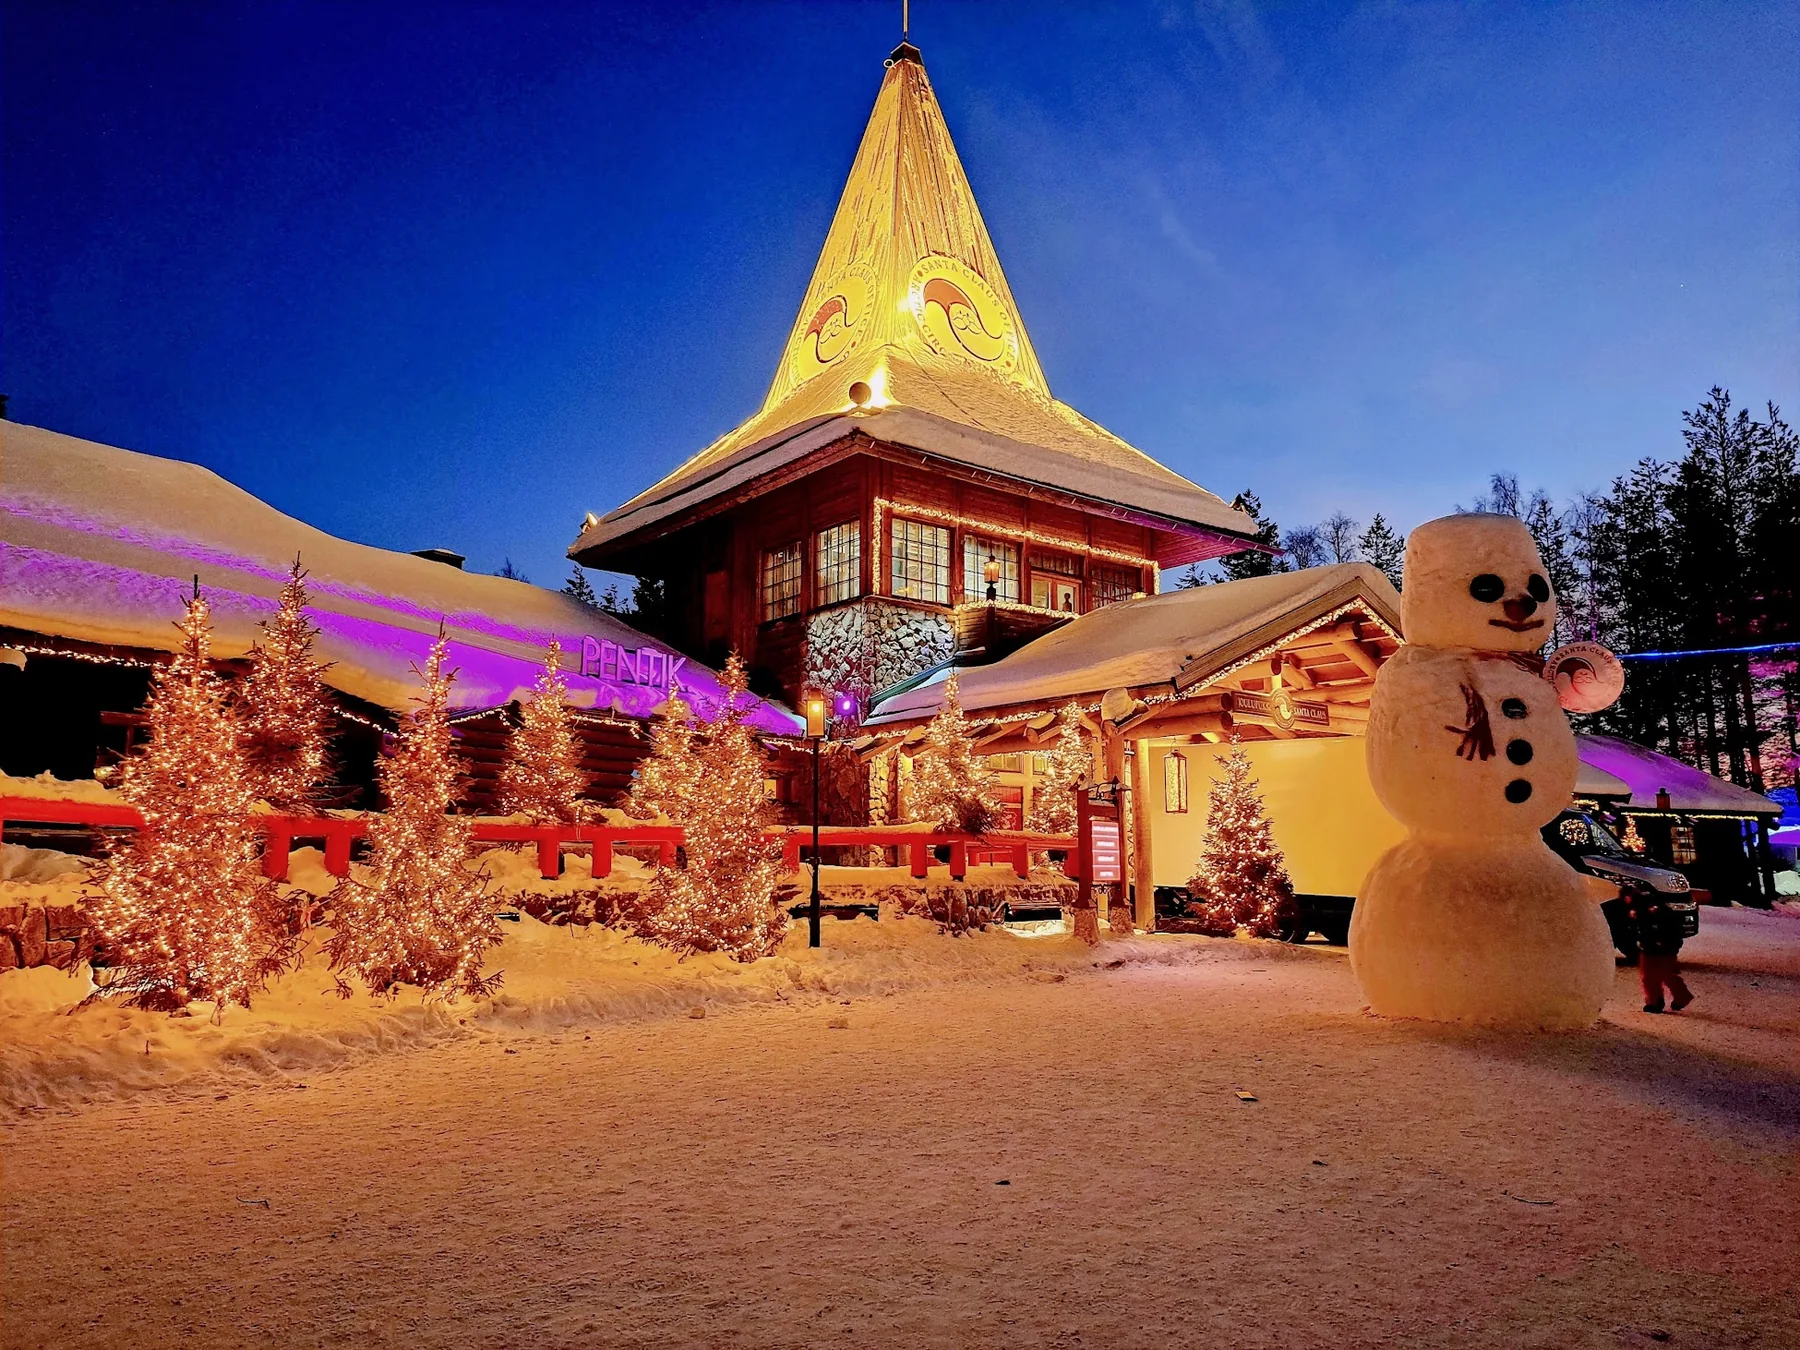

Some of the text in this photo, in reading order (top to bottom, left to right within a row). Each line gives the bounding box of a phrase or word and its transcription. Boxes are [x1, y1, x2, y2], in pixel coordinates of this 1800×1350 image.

[849, 267, 873, 285] CLAUS
[922, 259, 1016, 362] SANTA CLAUS OFFICE
[1560, 646, 1588, 659] SANTA
[581, 635, 687, 692] PENTIK
[1294, 706, 1311, 717] SANTA
[1311, 709, 1327, 720] CLAUS
